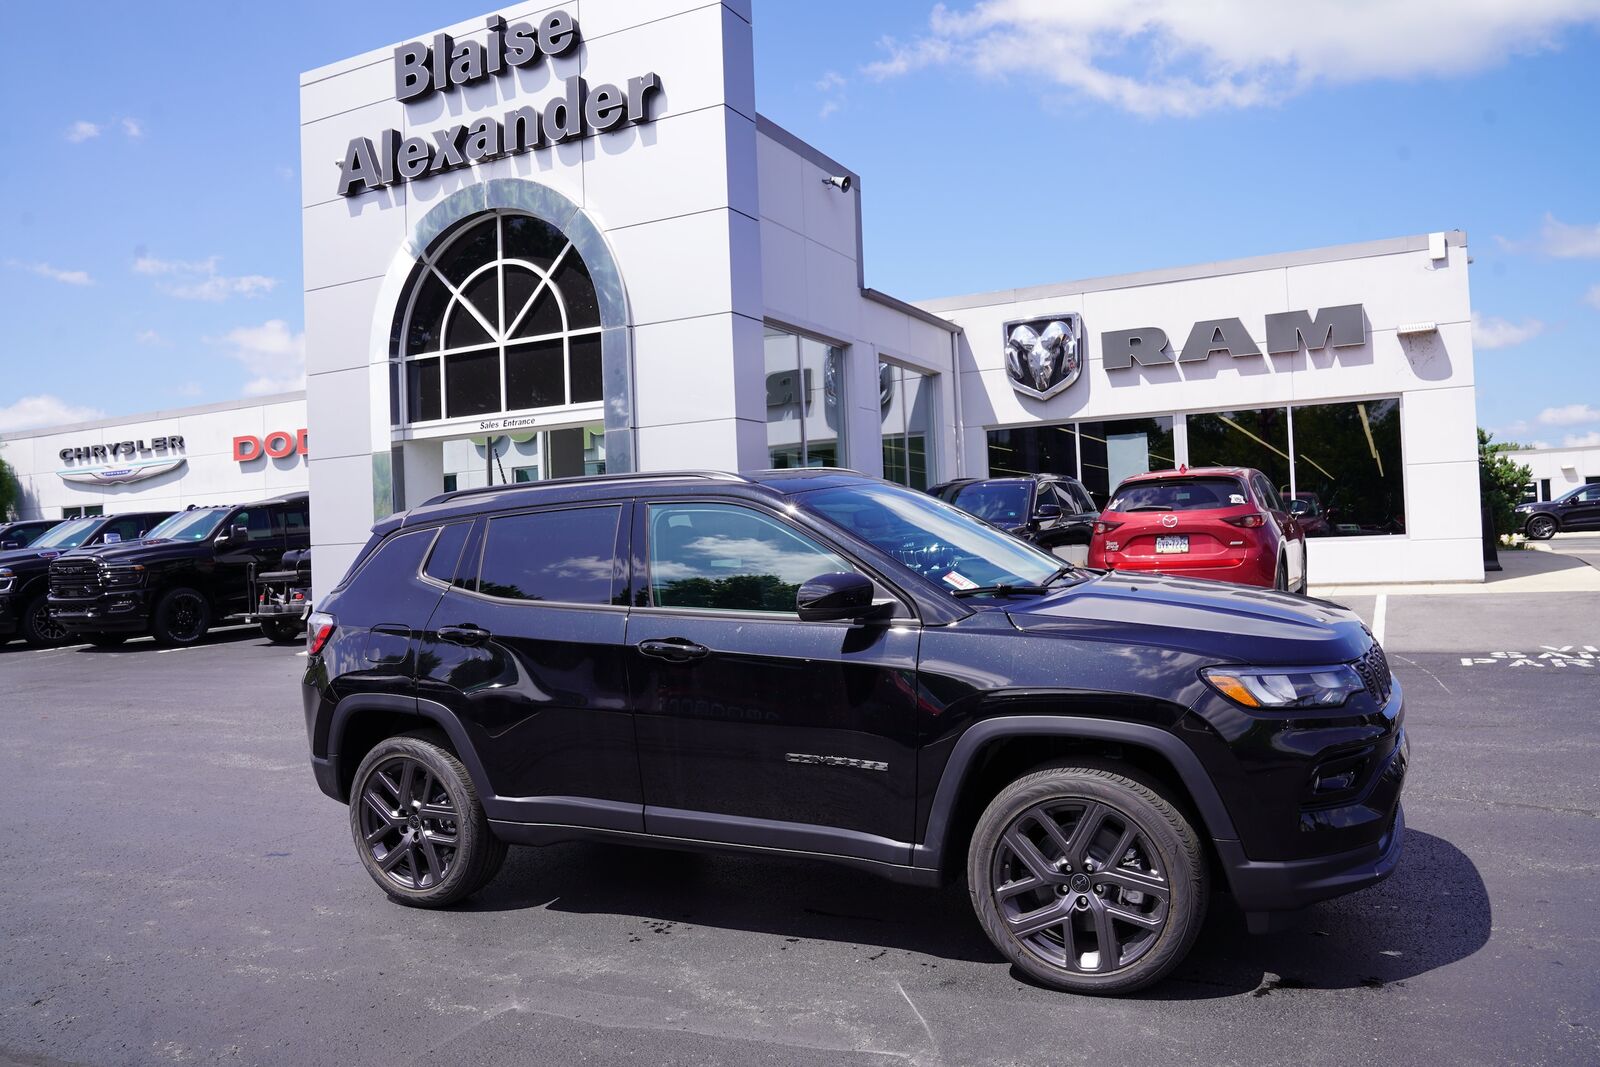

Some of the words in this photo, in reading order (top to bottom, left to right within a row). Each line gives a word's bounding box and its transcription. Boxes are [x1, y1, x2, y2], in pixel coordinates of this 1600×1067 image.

[394, 9, 579, 102] Blaise
[337, 72, 659, 197] Alexander
[1101, 303, 1366, 370] RAM
[59, 435, 185, 461] CHRYSLER
[480, 421, 499, 430] Sales
[503, 418, 536, 427] Entrance
